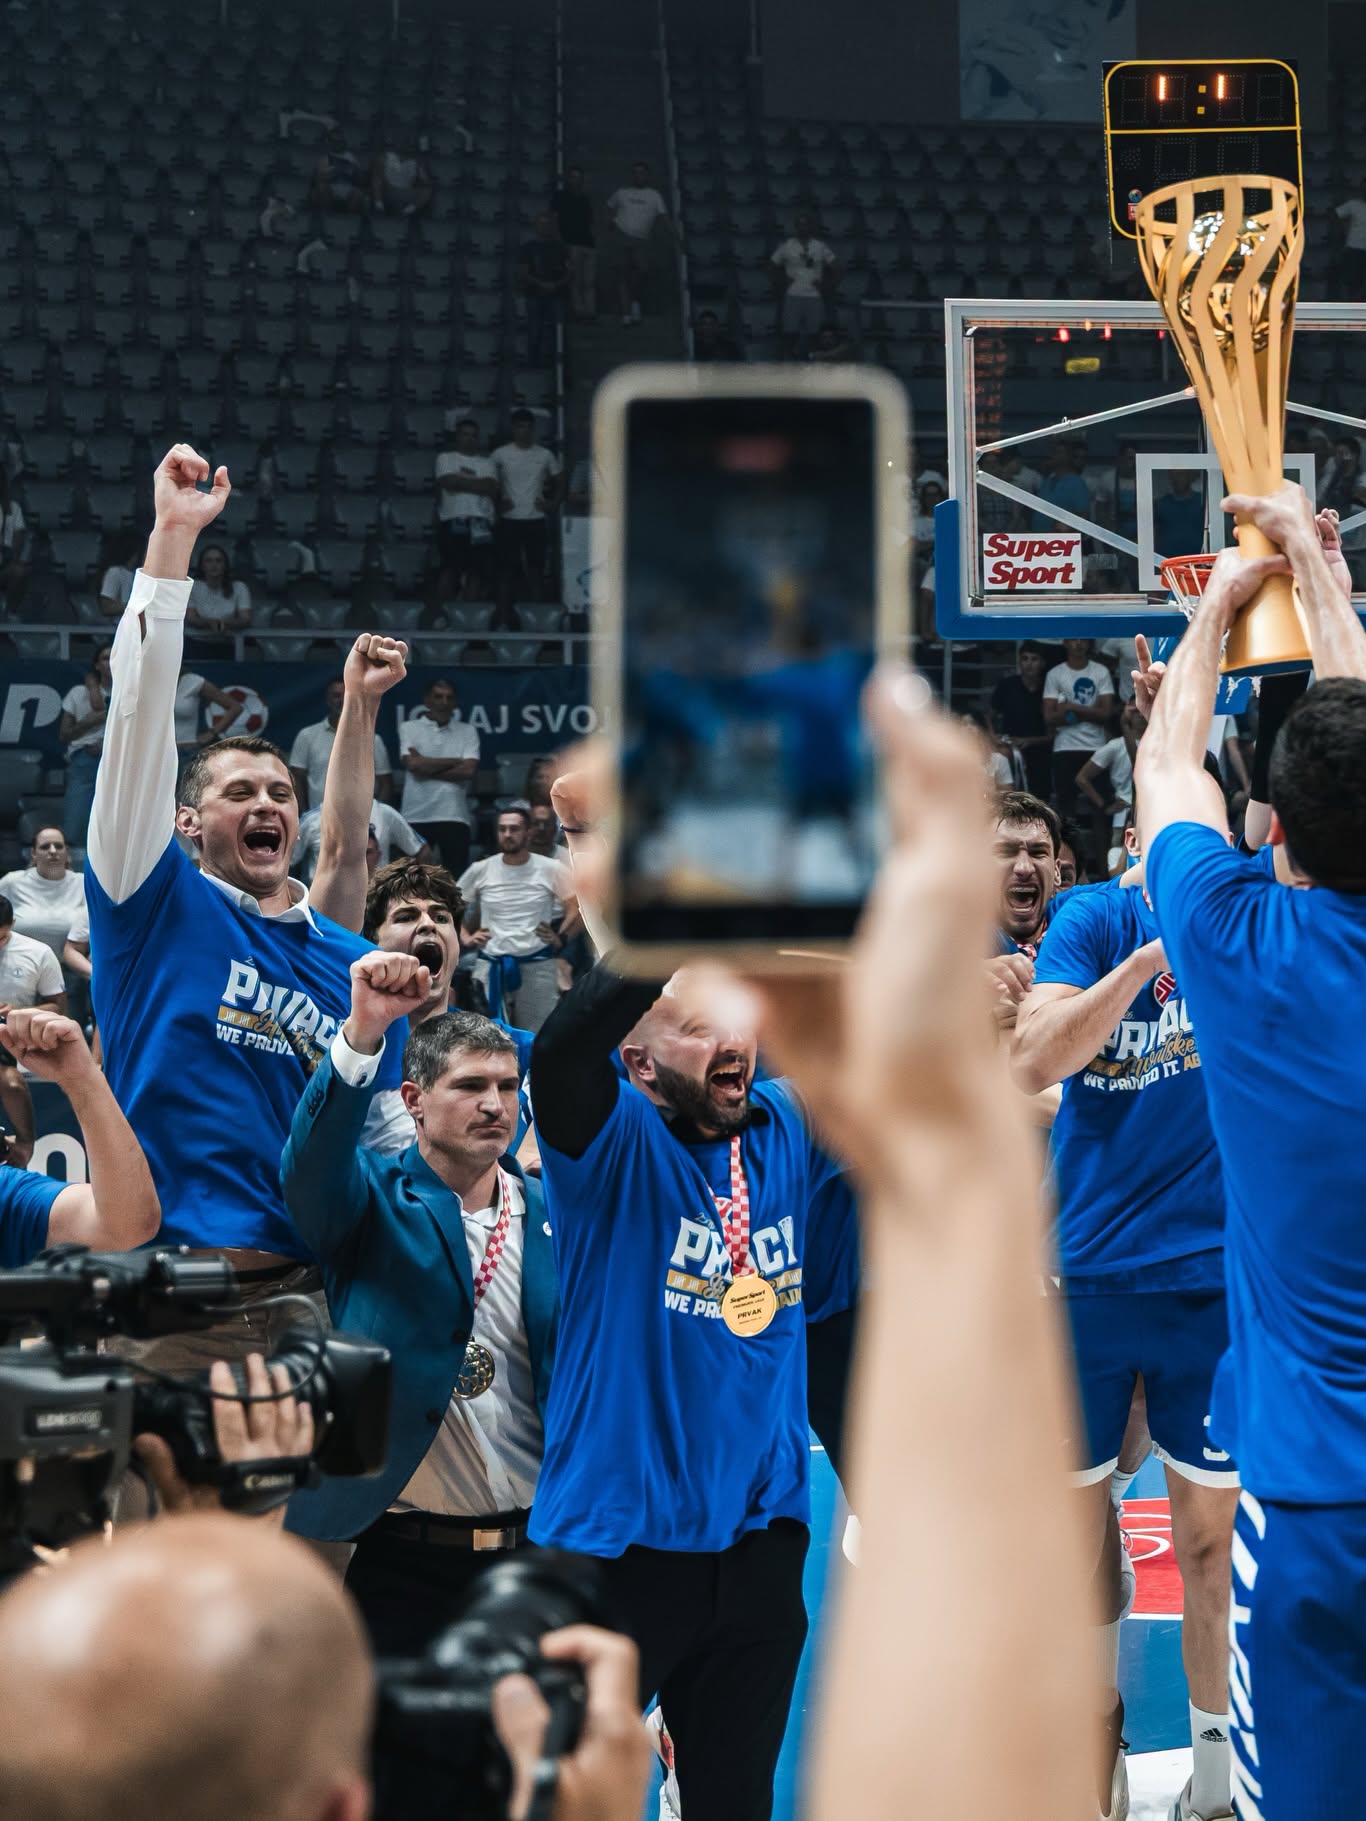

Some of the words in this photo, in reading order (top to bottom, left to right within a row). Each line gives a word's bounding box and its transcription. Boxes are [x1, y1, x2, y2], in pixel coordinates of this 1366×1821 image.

[984, 533, 1080, 562] Super
[988, 560, 1076, 589] Sport
[396, 704, 510, 734] IAJ
[216, 1023, 243, 1044] WE
[1084, 1072, 1105, 1091] WE
[664, 1290, 689, 1313] WE
[737, 1308, 762, 1319] PRVAK
[1200, 1733, 1228, 1743] adidas
